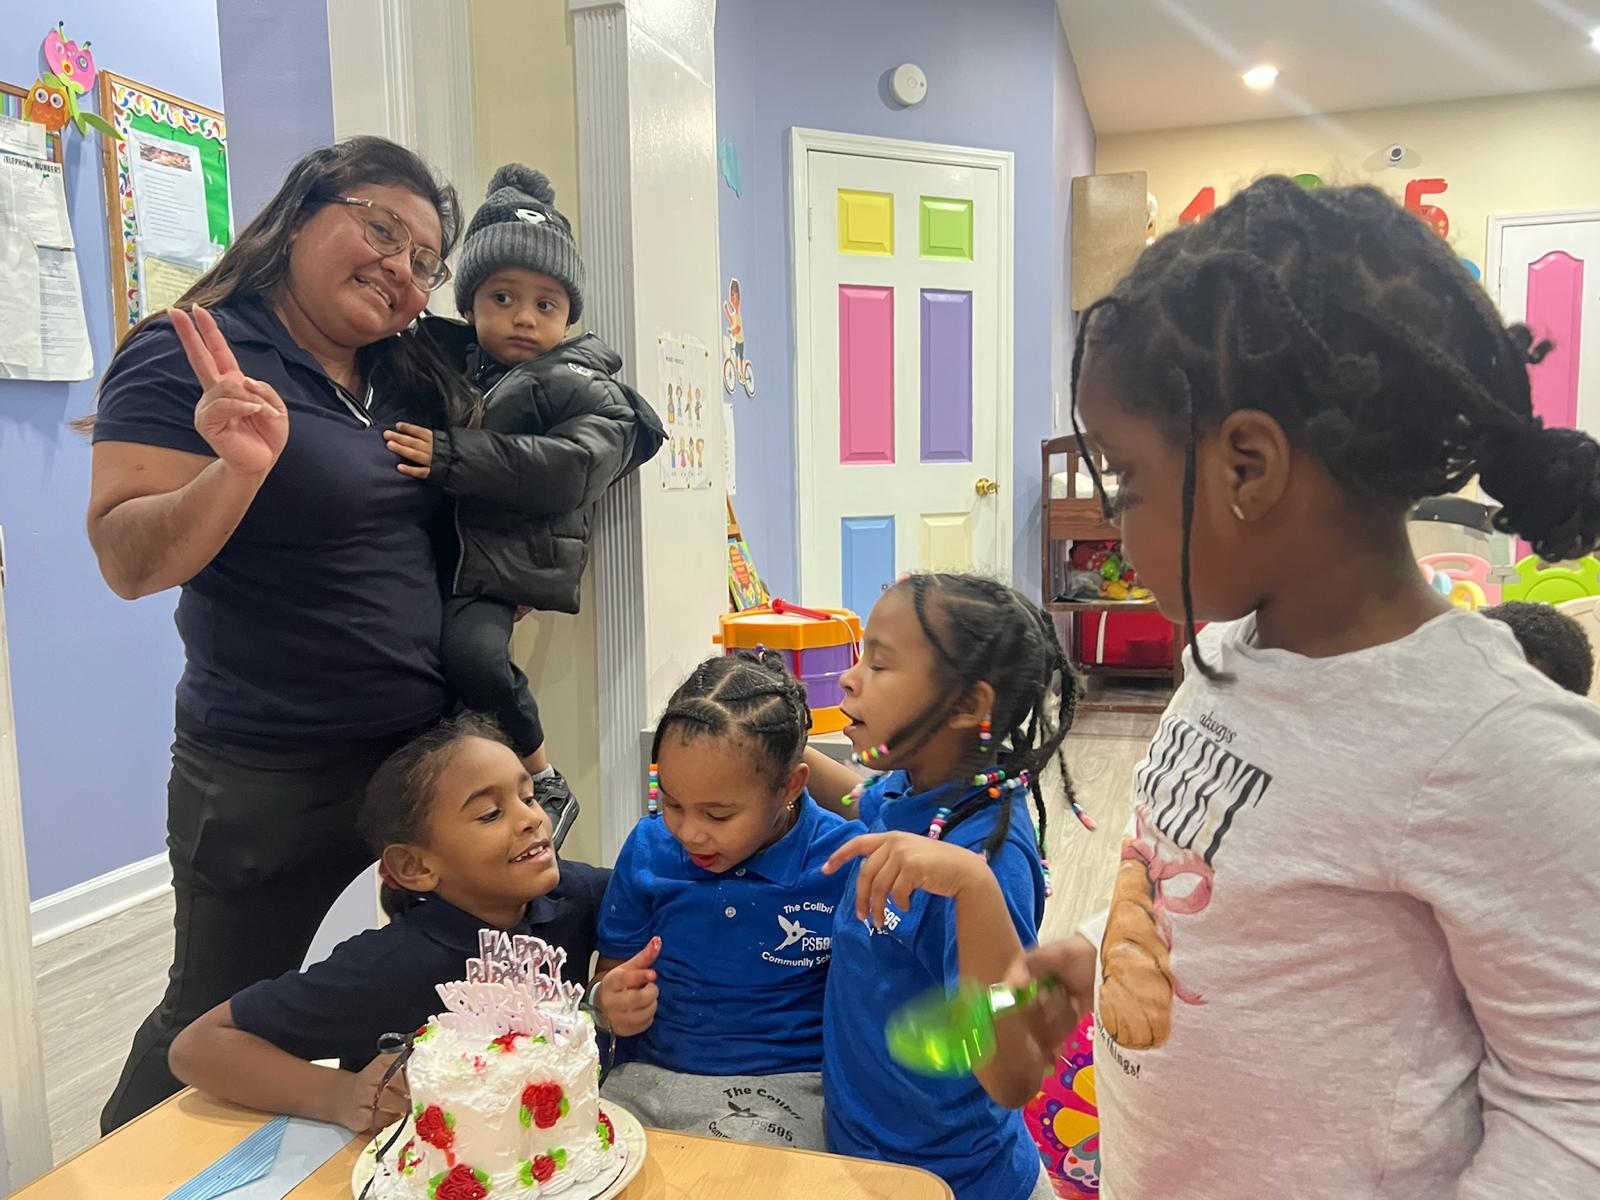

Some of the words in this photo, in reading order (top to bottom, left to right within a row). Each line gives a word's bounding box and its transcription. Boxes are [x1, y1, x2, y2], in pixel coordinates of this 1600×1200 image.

[35, 161, 62, 174] NUMBERS
[1199, 711, 1238, 744] always
[783, 904, 801, 914] The
[801, 936, 832, 952] PS59
[761, 951, 815, 968] Community
[723, 1087, 752, 1099] The
[750, 1119, 794, 1142] PS595
